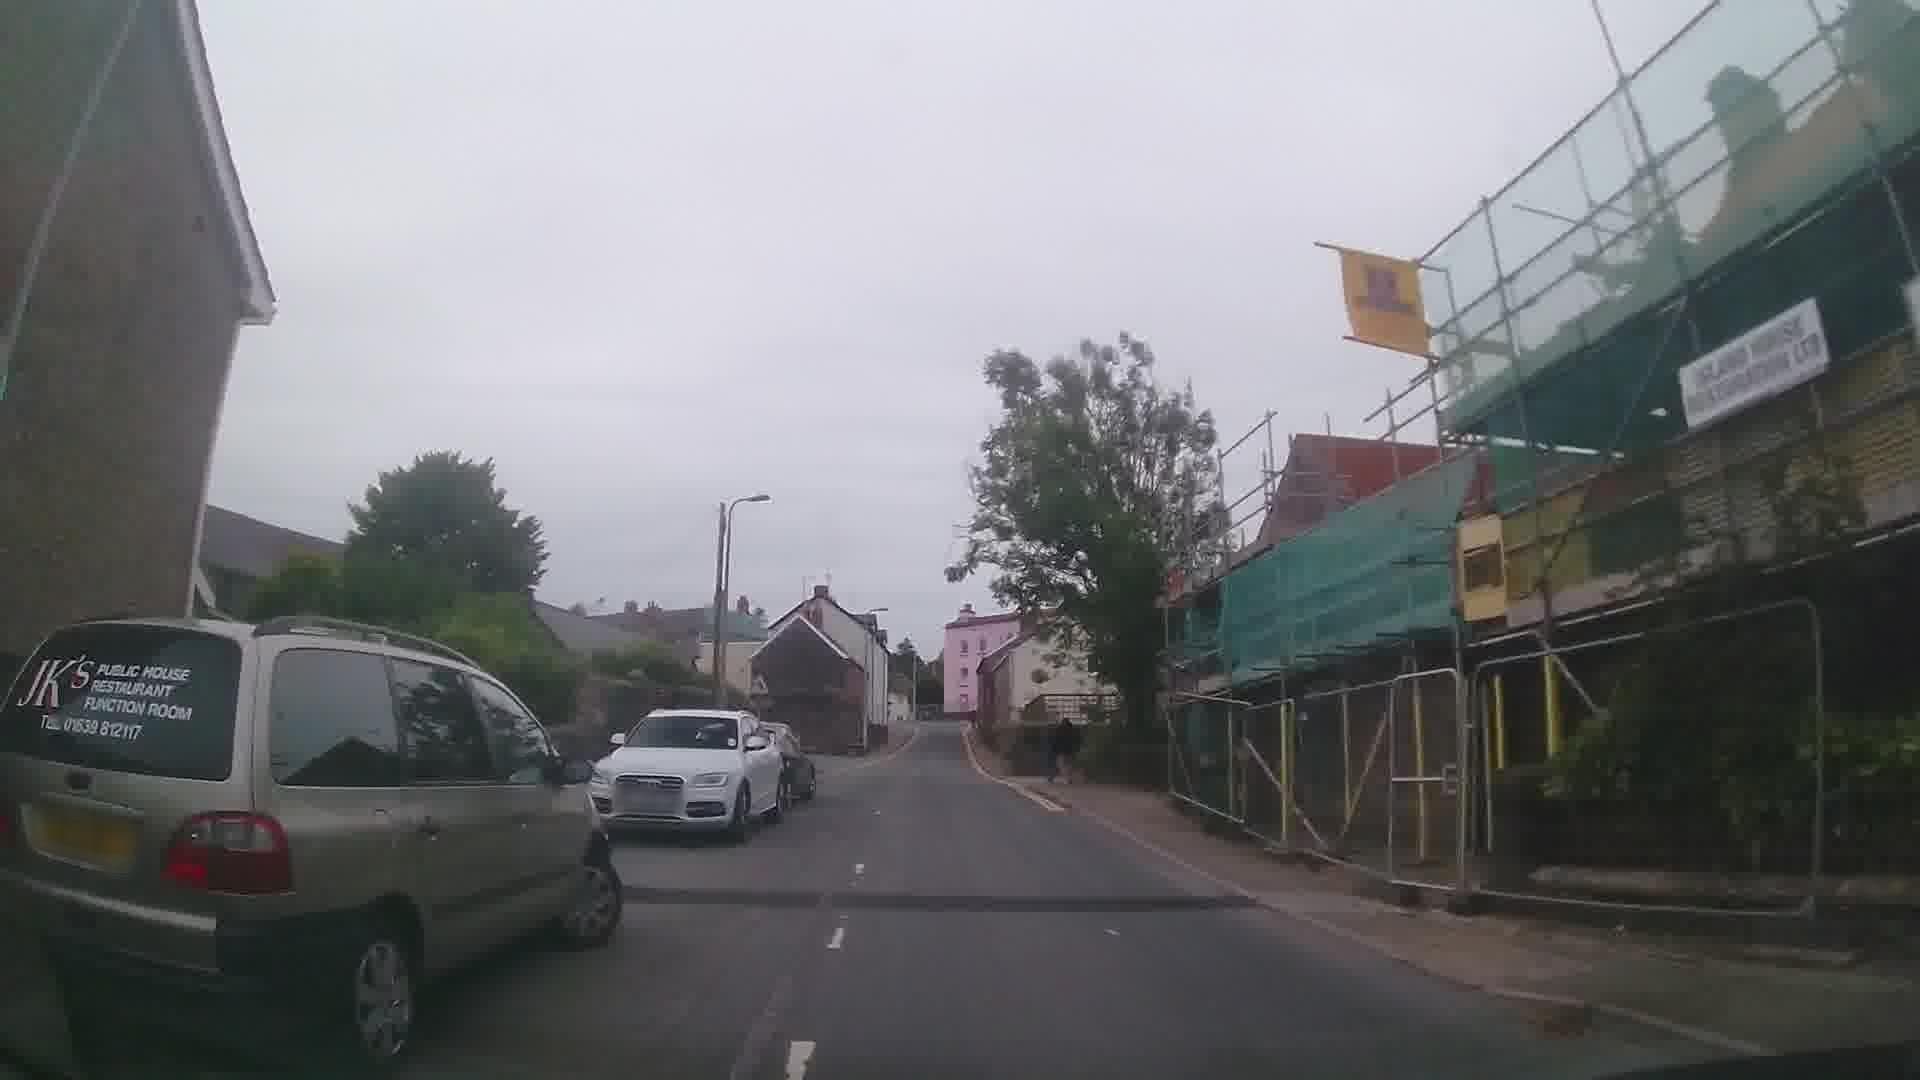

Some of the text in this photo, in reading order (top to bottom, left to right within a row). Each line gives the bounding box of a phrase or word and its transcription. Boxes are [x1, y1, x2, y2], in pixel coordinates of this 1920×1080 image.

[97, 664, 191, 682] PUBLIC HOUSE
[91, 680, 173, 697] RESTAURANT
[84, 697, 192, 721] FUNCTION ROOM
